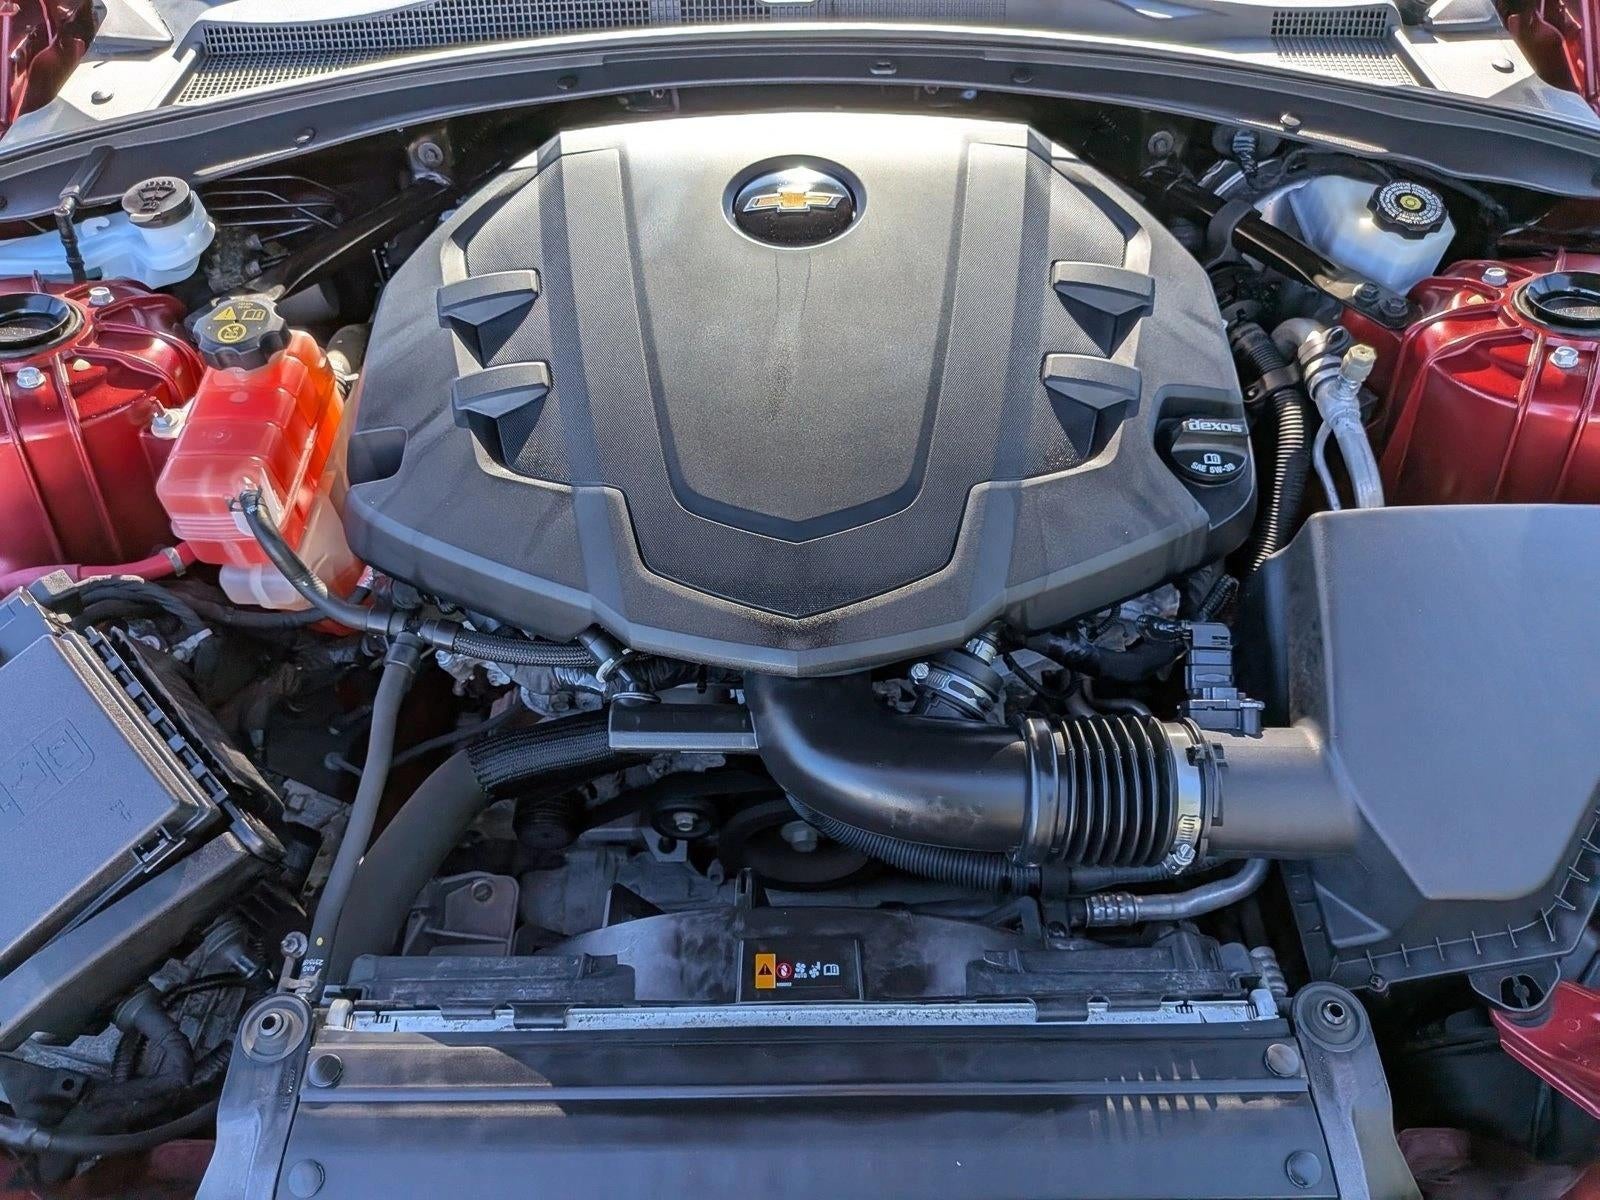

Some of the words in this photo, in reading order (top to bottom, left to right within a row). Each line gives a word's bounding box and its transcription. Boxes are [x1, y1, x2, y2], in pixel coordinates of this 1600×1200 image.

[1189, 418, 1242, 433] dexos
[1191, 461, 1207, 473] SAE
[1209, 462, 1236, 474] 5W-30
